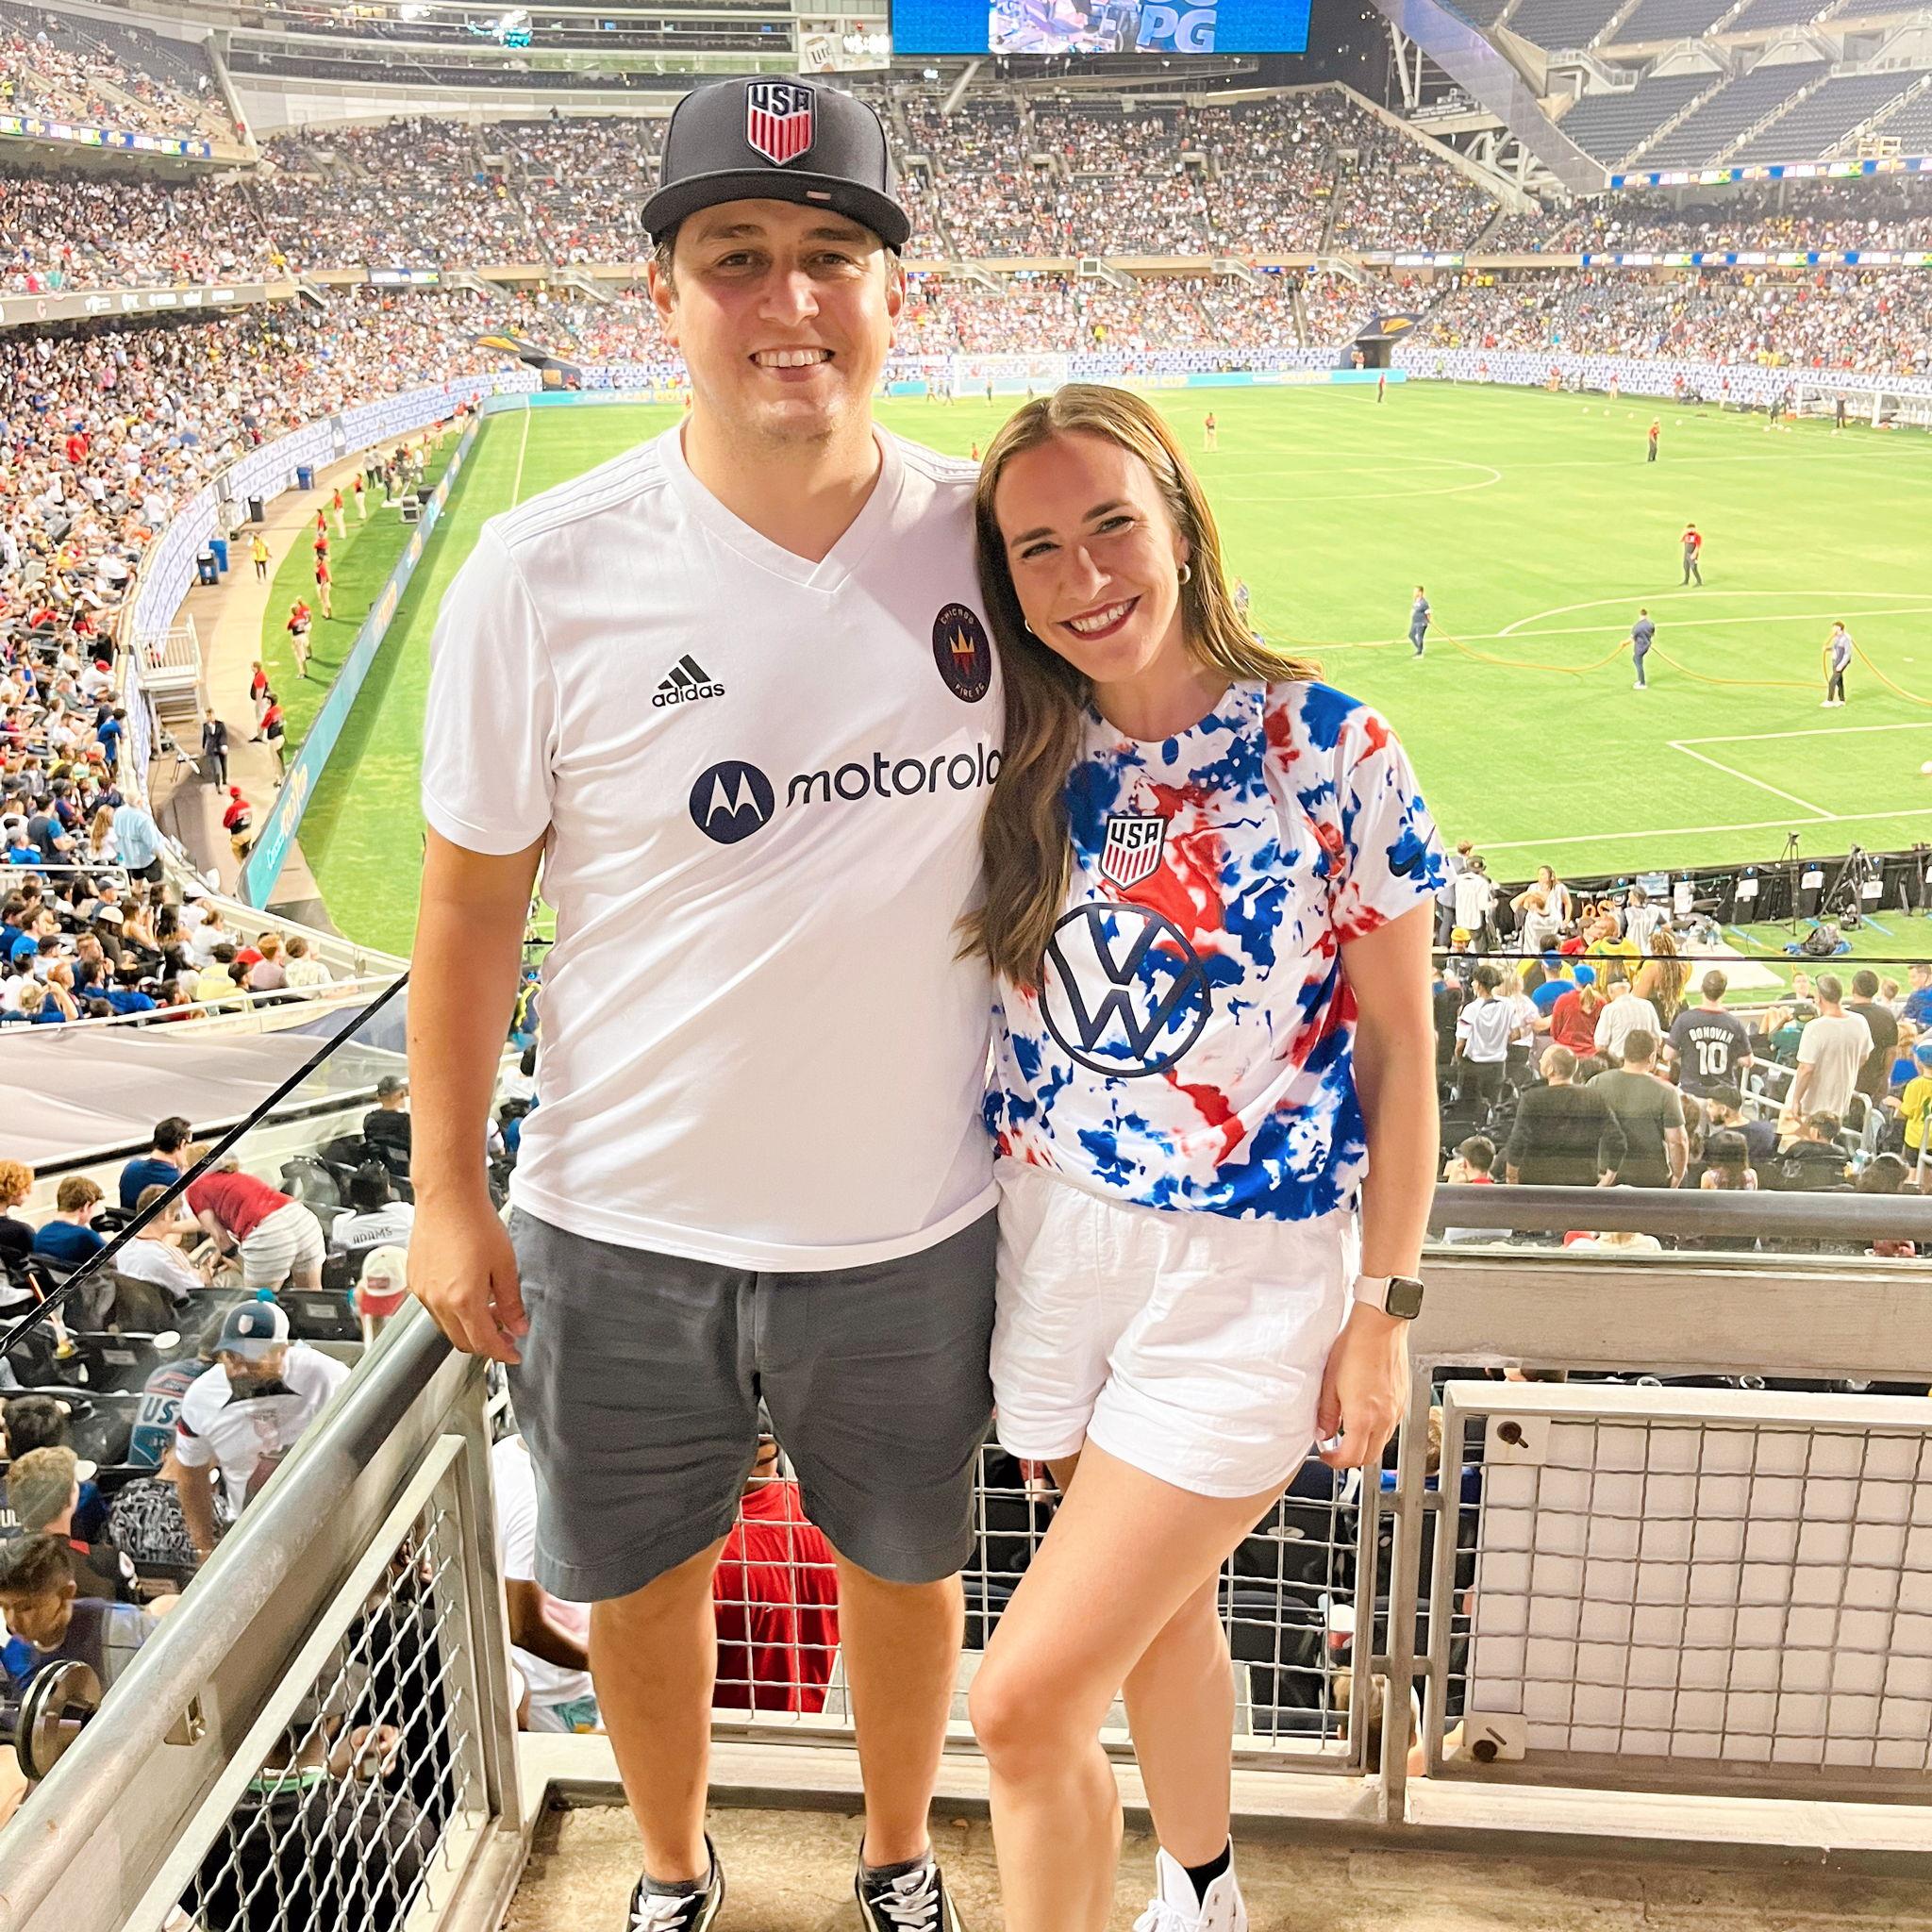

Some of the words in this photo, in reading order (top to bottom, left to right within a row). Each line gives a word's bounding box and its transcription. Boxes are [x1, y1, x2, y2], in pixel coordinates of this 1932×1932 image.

[752, 85, 809, 116] USA
[941, 608, 974, 625] CHICAGO
[652, 684, 725, 708] adidas
[955, 683, 973, 698] FIRE
[1111, 823, 1159, 849] USA
[1695, 1041, 1728, 1075] 10
[353, 1226, 393, 1244] ADAMS
